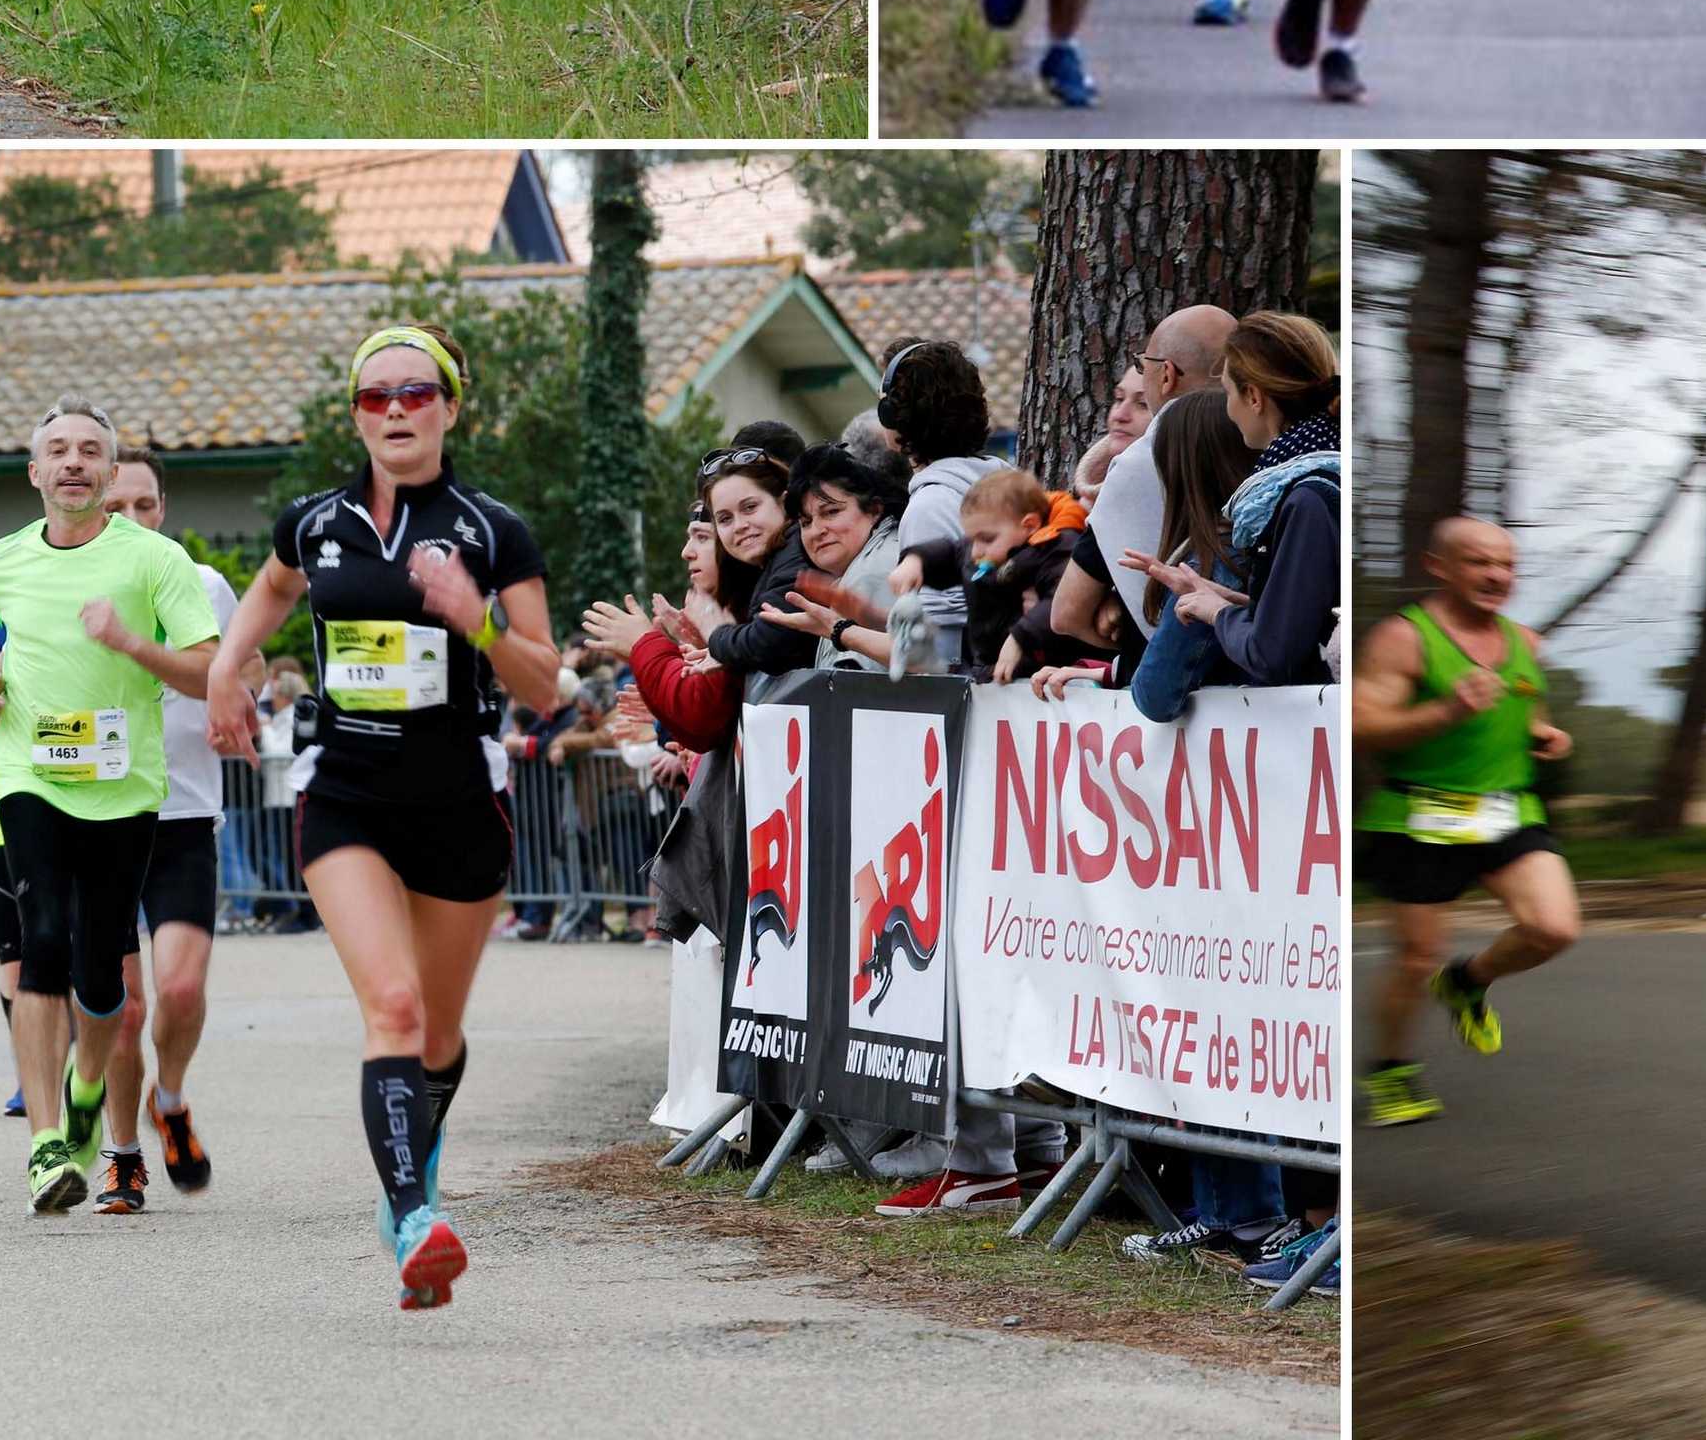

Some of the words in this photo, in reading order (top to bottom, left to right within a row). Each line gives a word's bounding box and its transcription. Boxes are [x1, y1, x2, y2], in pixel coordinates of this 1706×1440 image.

[347, 666, 385, 681] 1170
[48, 747, 78, 759] 1463
[991, 720, 1260, 892] NISSAN
[984, 896, 1056, 960] Votre
[1239, 937, 1275, 986] sur
[1280, 922, 1300, 988] le
[845, 1039, 867, 1073] HIT
[865, 1042, 905, 1081] MUSIC
[904, 1048, 935, 1086] ONLY
[1068, 993, 1105, 1068] LA
[1112, 999, 1198, 1085] TESTE
[1207, 1014, 1240, 1092] de
[1250, 1017, 1332, 1103] BUCH
